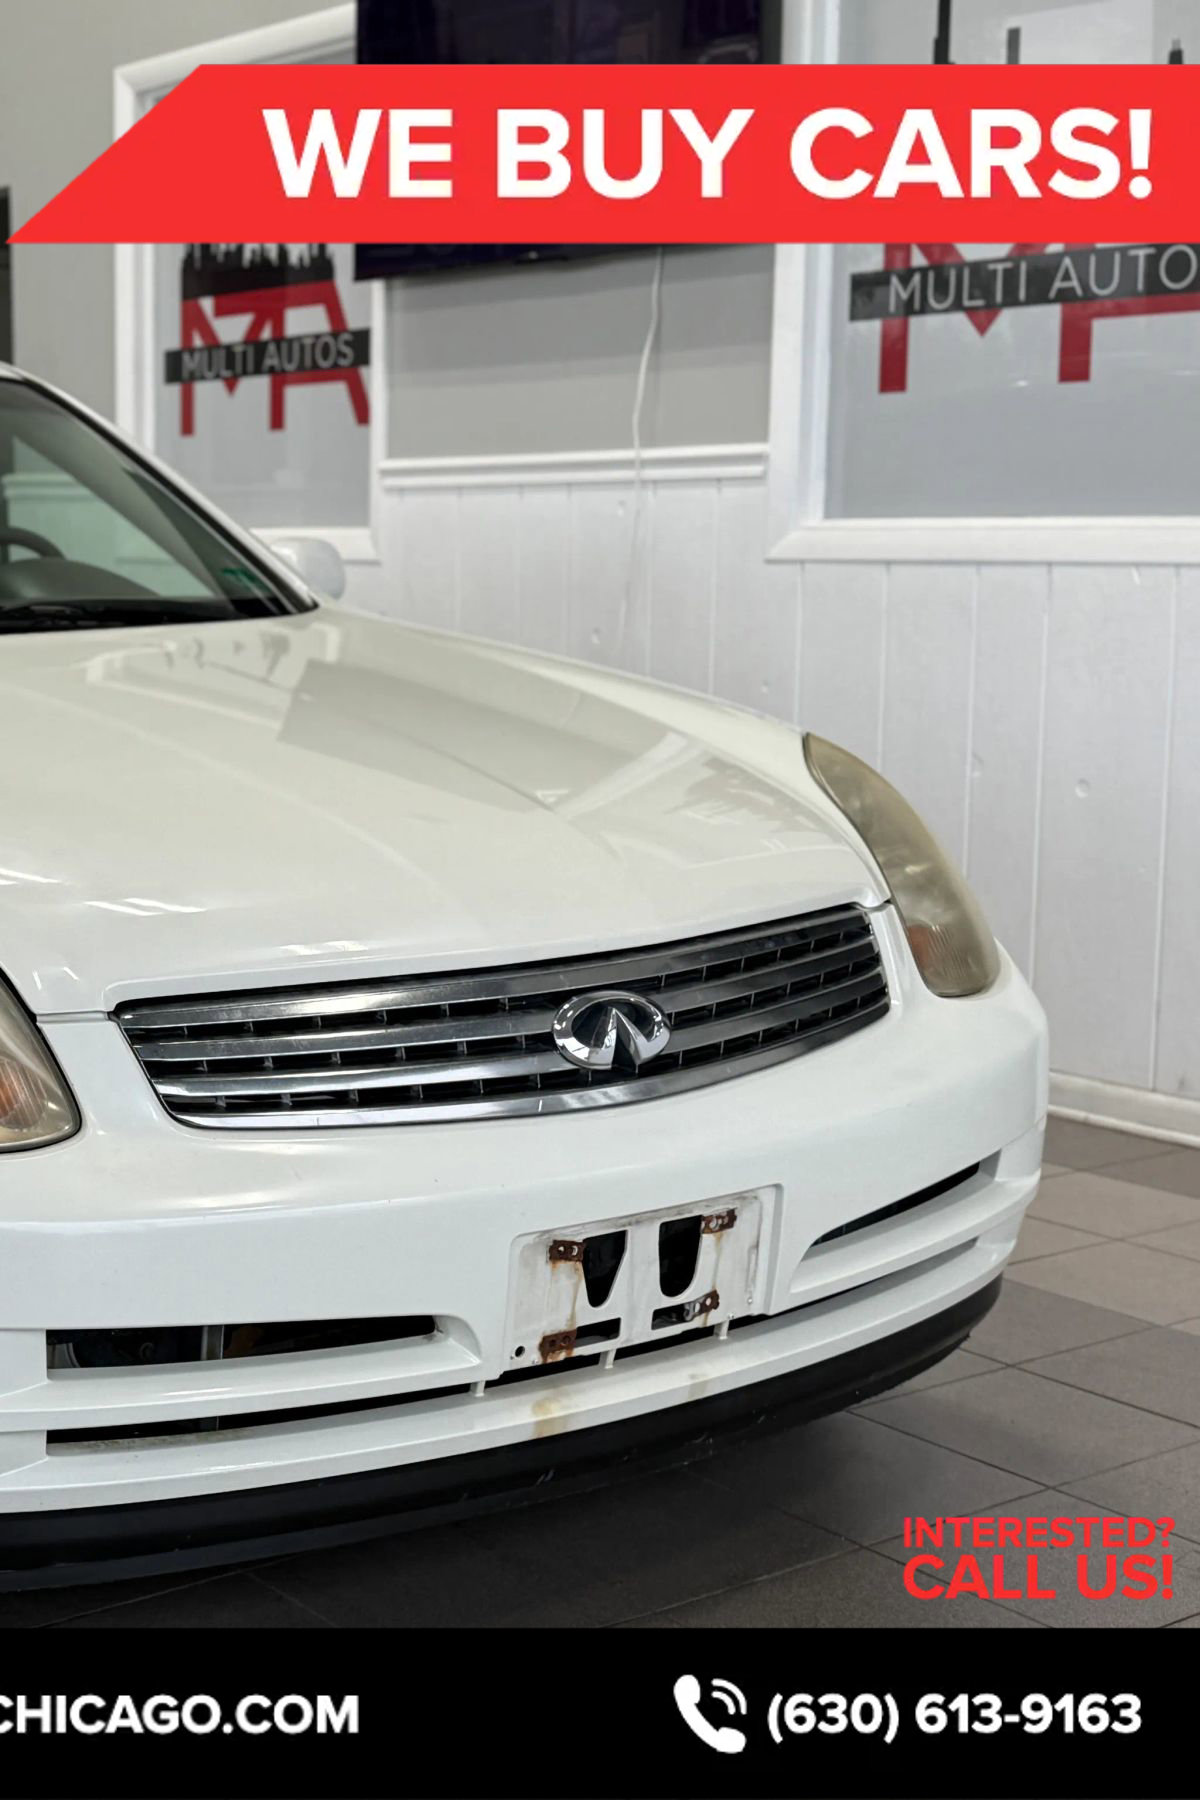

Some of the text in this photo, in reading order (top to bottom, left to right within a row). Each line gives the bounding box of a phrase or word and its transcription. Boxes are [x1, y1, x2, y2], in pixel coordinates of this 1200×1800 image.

[887, 260, 1027, 315] MULTI
[181, 332, 355, 380] MULTI AUTOS
